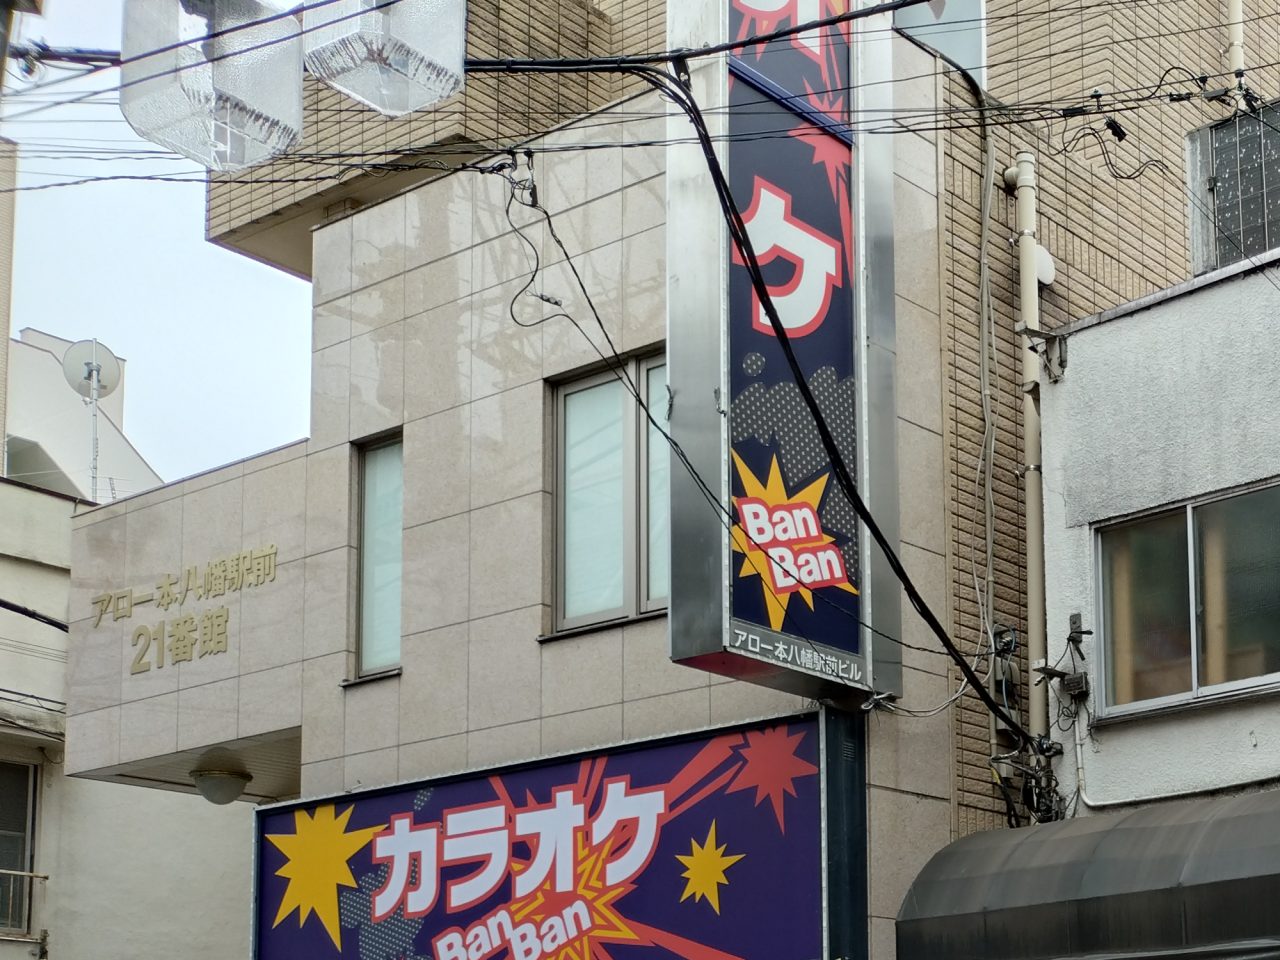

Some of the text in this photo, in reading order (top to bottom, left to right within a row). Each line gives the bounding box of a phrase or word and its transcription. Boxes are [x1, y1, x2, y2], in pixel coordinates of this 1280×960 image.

[742, 503, 818, 544] Ban
[92, 544, 277, 628] アロー本八幡駅前
[768, 547, 843, 588] Ban
[130, 605, 229, 675] 21番館
[734, 630, 861, 681] アロー本八幡駅前ビル
[373, 782, 664, 918] カラオケ
